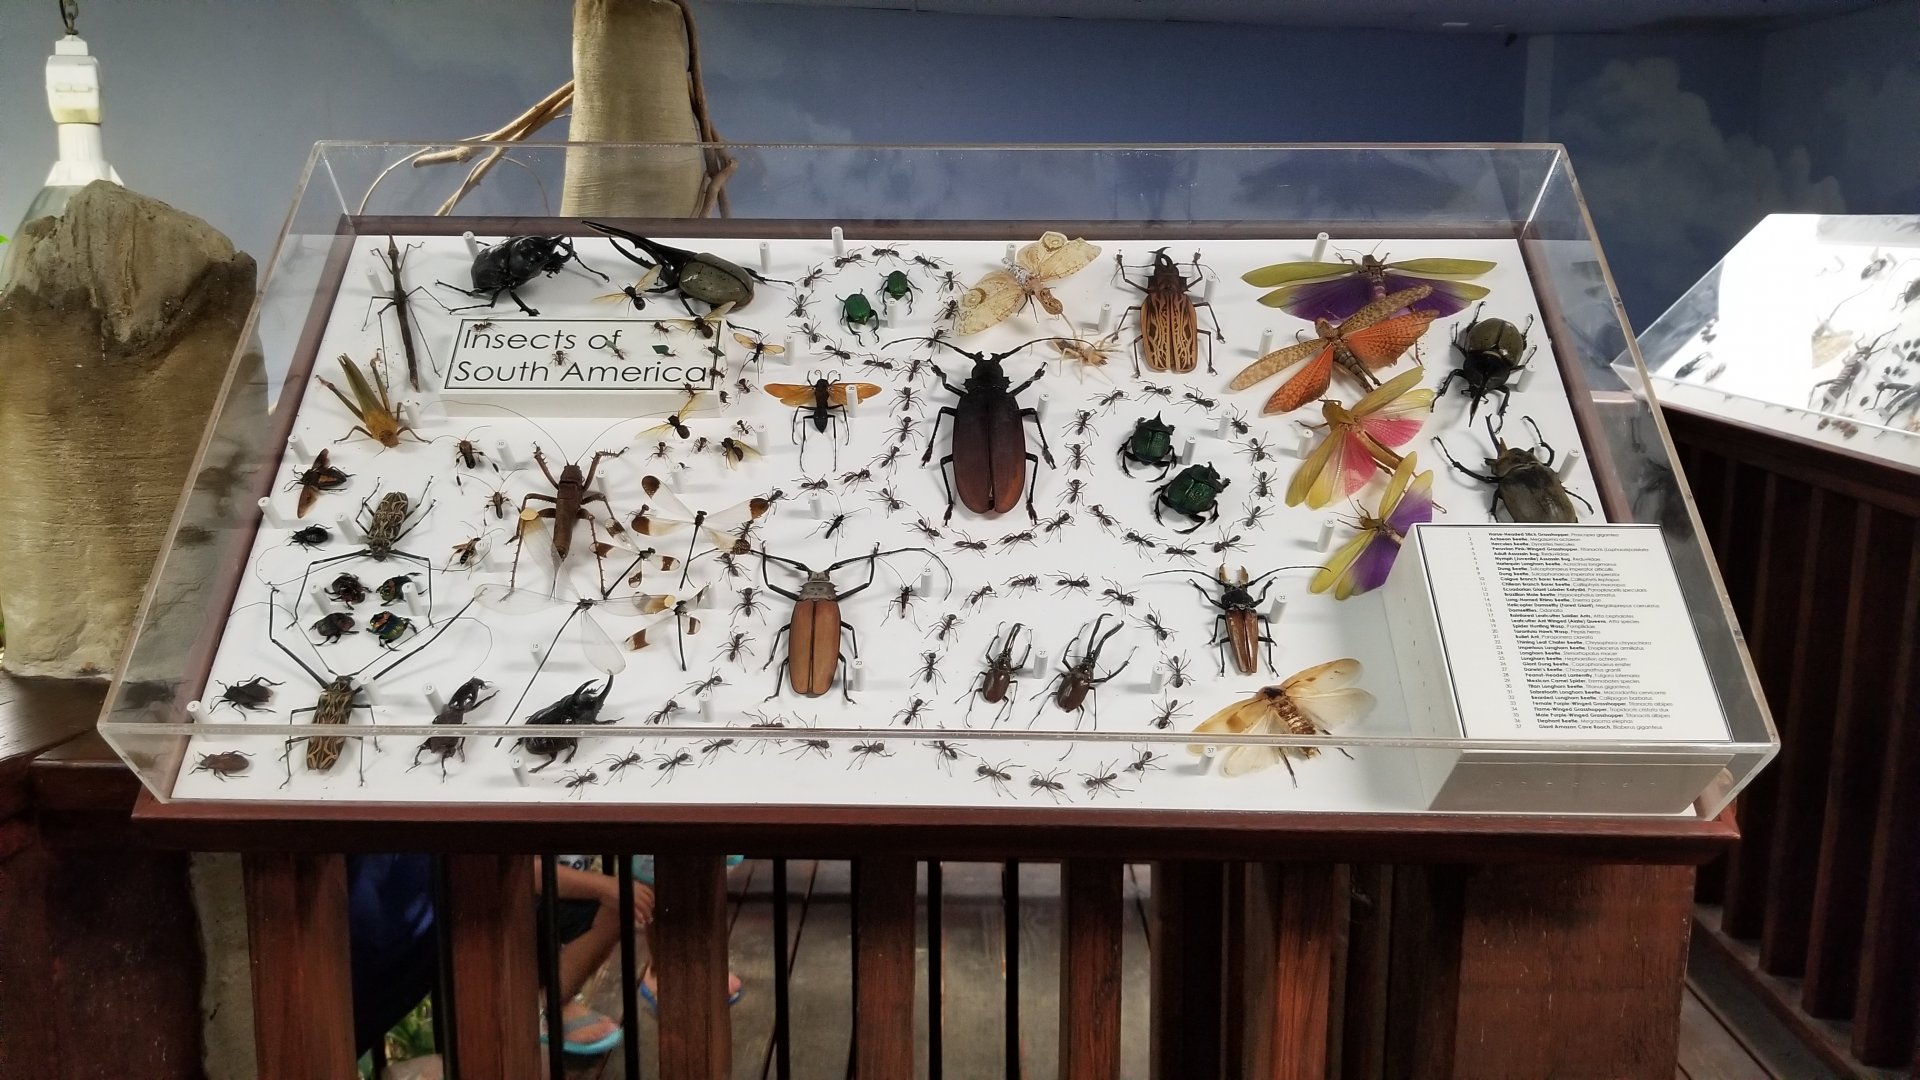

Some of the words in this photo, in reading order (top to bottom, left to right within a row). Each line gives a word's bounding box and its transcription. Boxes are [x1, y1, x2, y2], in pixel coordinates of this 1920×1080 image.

[464, 330, 576, 349] Insects
[588, 330, 622, 349] of
[454, 361, 549, 382] South
[560, 362, 706, 382] America
